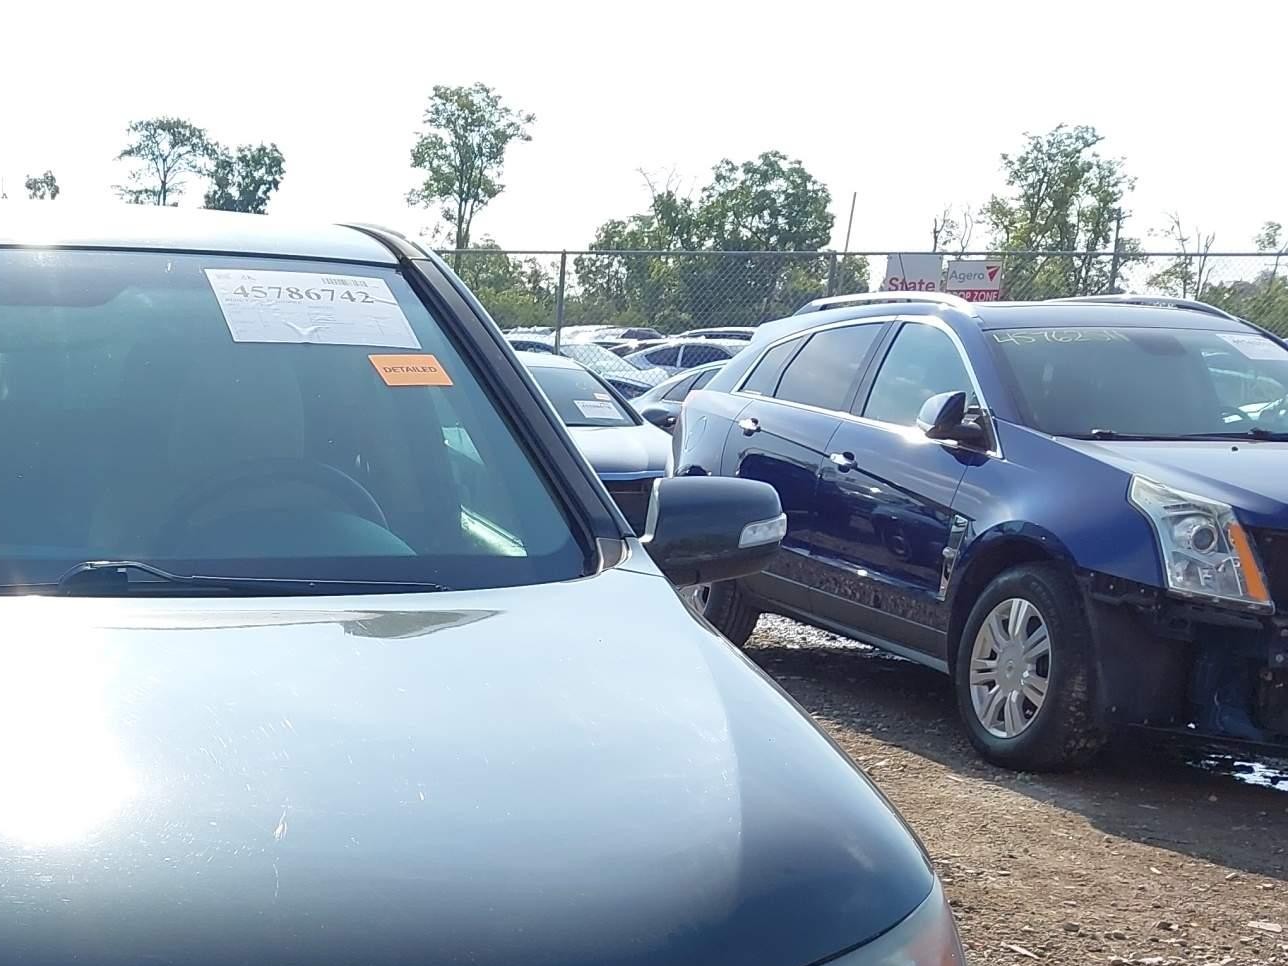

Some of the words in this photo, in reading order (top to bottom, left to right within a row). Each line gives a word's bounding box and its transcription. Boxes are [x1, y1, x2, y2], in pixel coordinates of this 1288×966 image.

[949, 270, 985, 283] Agero
[888, 277, 936, 291] State
[232, 285, 375, 304] 45786742
